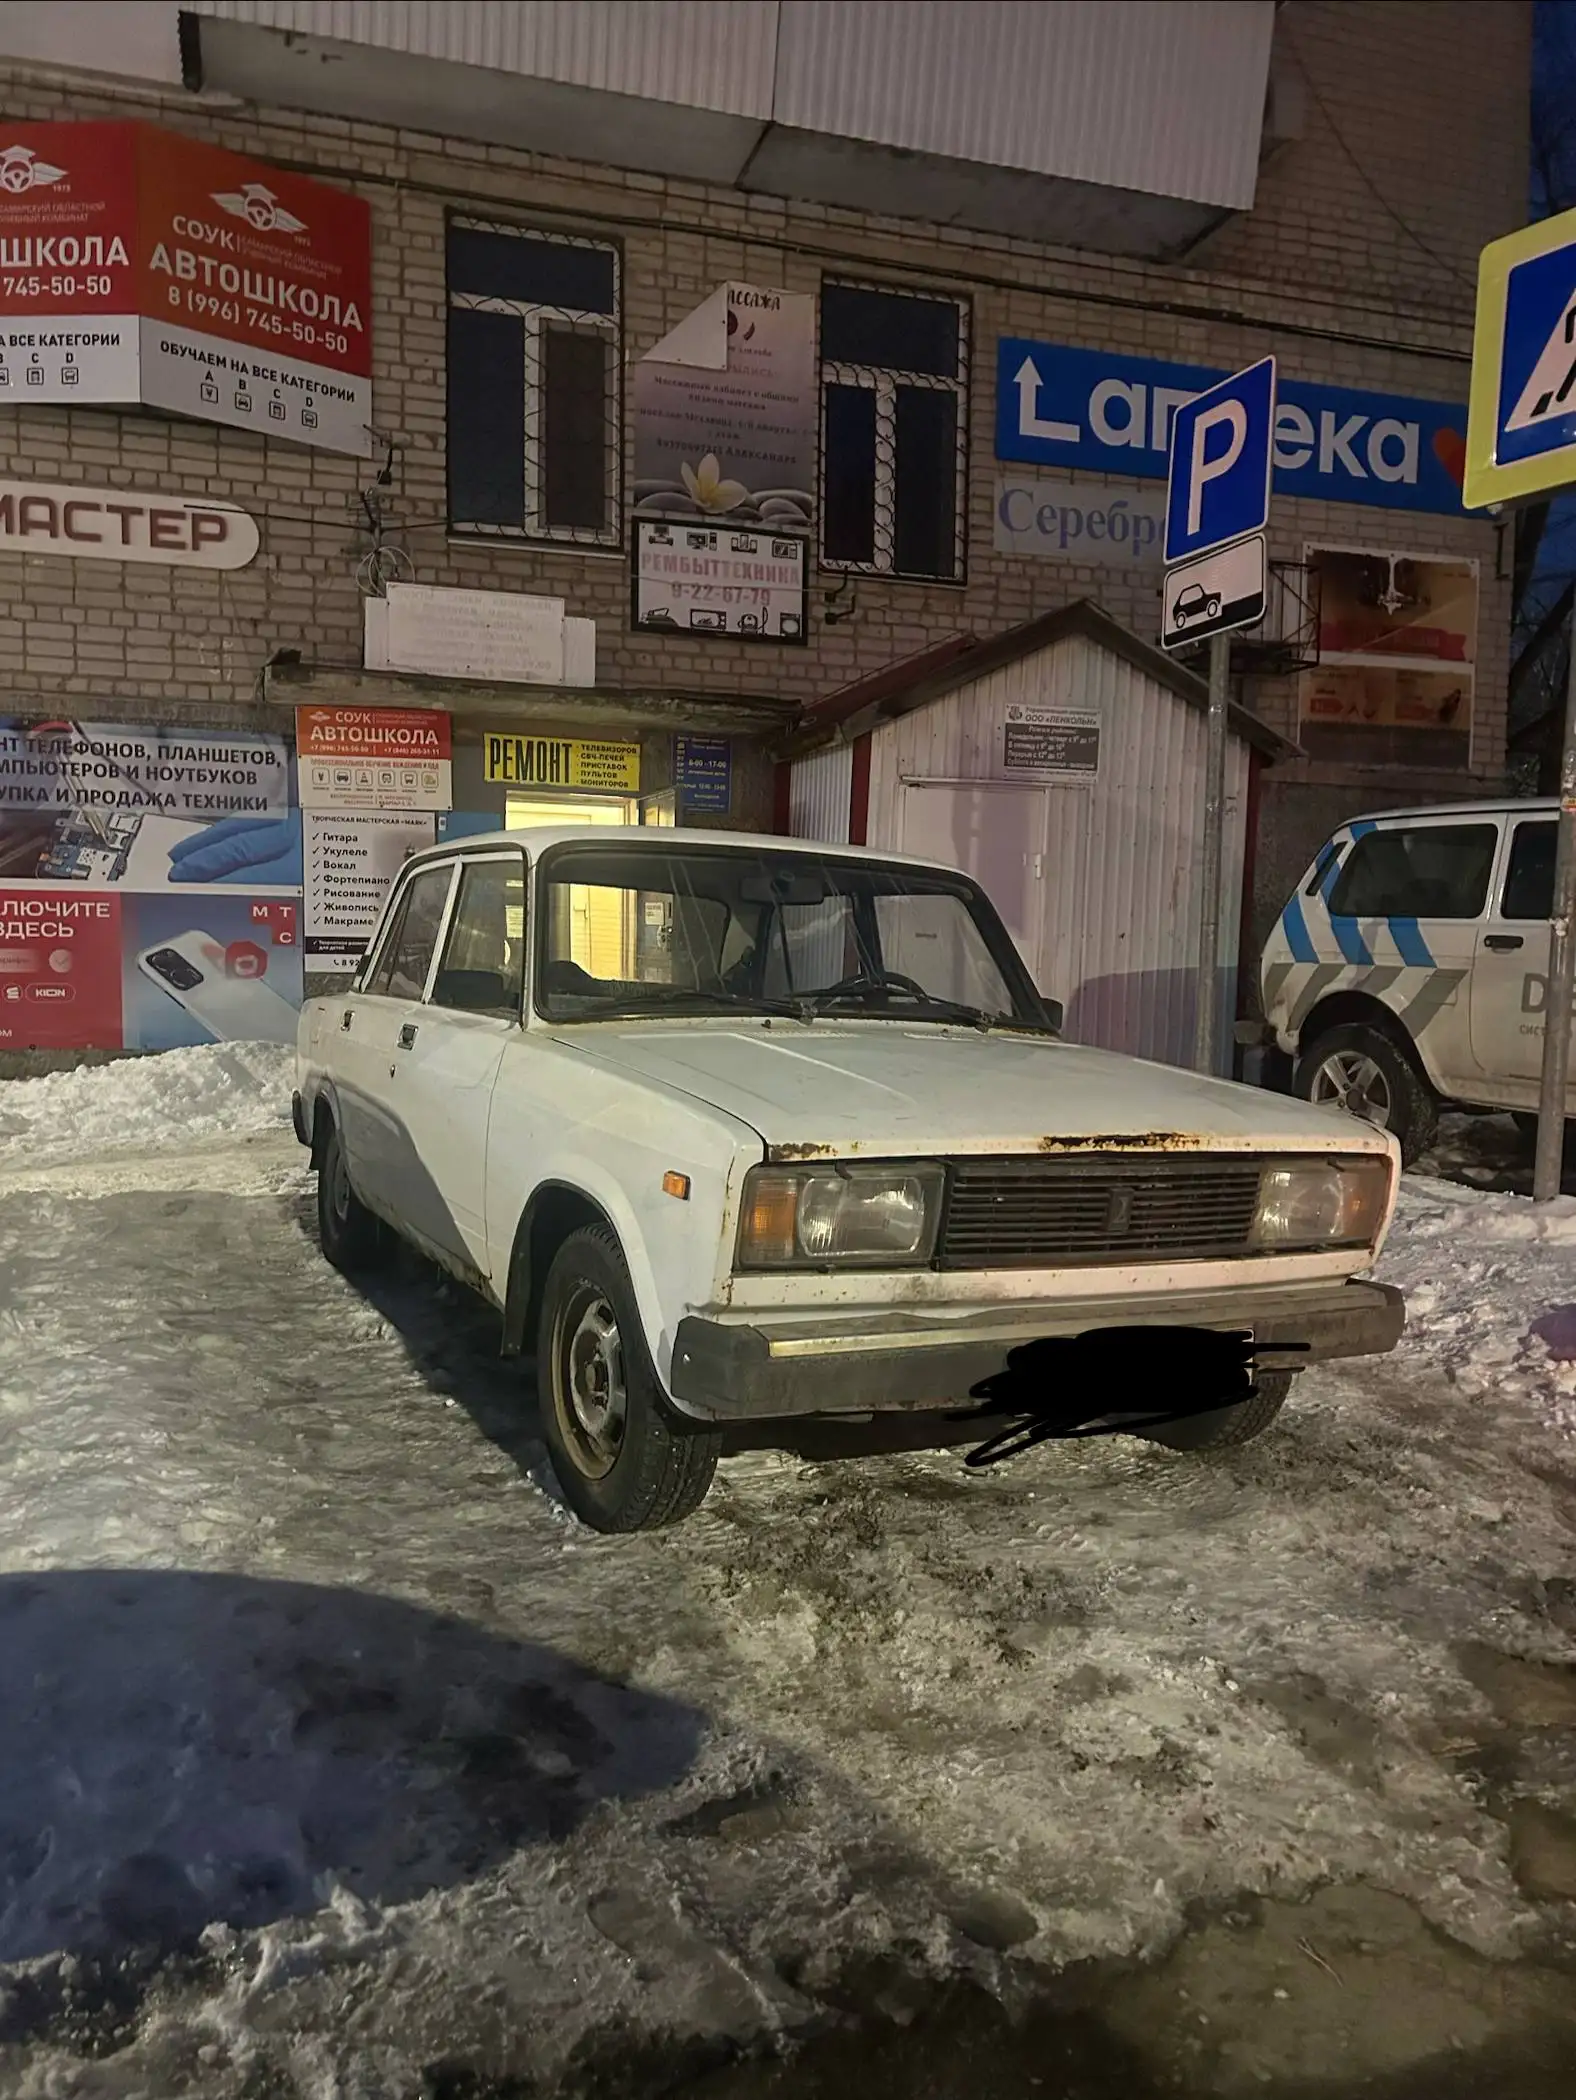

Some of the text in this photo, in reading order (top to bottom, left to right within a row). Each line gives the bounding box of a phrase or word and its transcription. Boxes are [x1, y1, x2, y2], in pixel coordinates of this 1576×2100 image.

[172, 215, 235, 251] СОУК
[0, 235, 130, 267] ШКОЛА
[3, 275, 112, 297] 745-50-50
[150, 242, 364, 332] АВТОШКОЛА
[168, 286, 348, 354] 8 (996) 745-50-50
[9, 334, 36, 346] ВСЕ
[39, 333, 120, 346] КАТЕГОРИИ
[160, 340, 355, 402] ОБУЧАЕМ НА ВСЕ КАТЕГОРИИ
[335, 711, 372, 724] СОУК
[310, 725, 439, 745] АВТОШКОЛА
[26, 738, 151, 761] ТЕЛЕФОНОВ,
[158, 745, 281, 768] ПЛАНШЕТОВ,
[581, 743, 637, 754] ТЕЛЕВИЗОРОВ
[489, 736, 573, 784] РЕМОНТ
[580, 761, 628, 771] ПРИСТАВОК
[126, 765, 139, 780] И
[146, 765, 258, 785] НОУТБУКОВ
[580, 770, 618, 779] ПУЛЬТОВ
[580, 778, 629, 788] МОНИТОРОВ
[56, 788, 69, 803] И
[76, 788, 177, 808] ПРОДАЖА
[182, 793, 268, 811] ТЕХНИКИ
[312, 815, 355, 823] ТВОРЧЕСКАЯ
[356, 816, 400, 825] МАСТЕРСКАЯ
[323, 832, 358, 843] Гитара
[323, 846, 368, 857] Укулеле
[323, 861, 357, 869] Вокал
[323, 874, 390, 886] Фортепиано
[323, 889, 381, 898] Рисование
[1, 900, 110, 918] ЛЮЧИТЕ
[324, 902, 380, 912] Живопись
[324, 916, 374, 927] Макраме
[35, 988, 66, 997] KION
